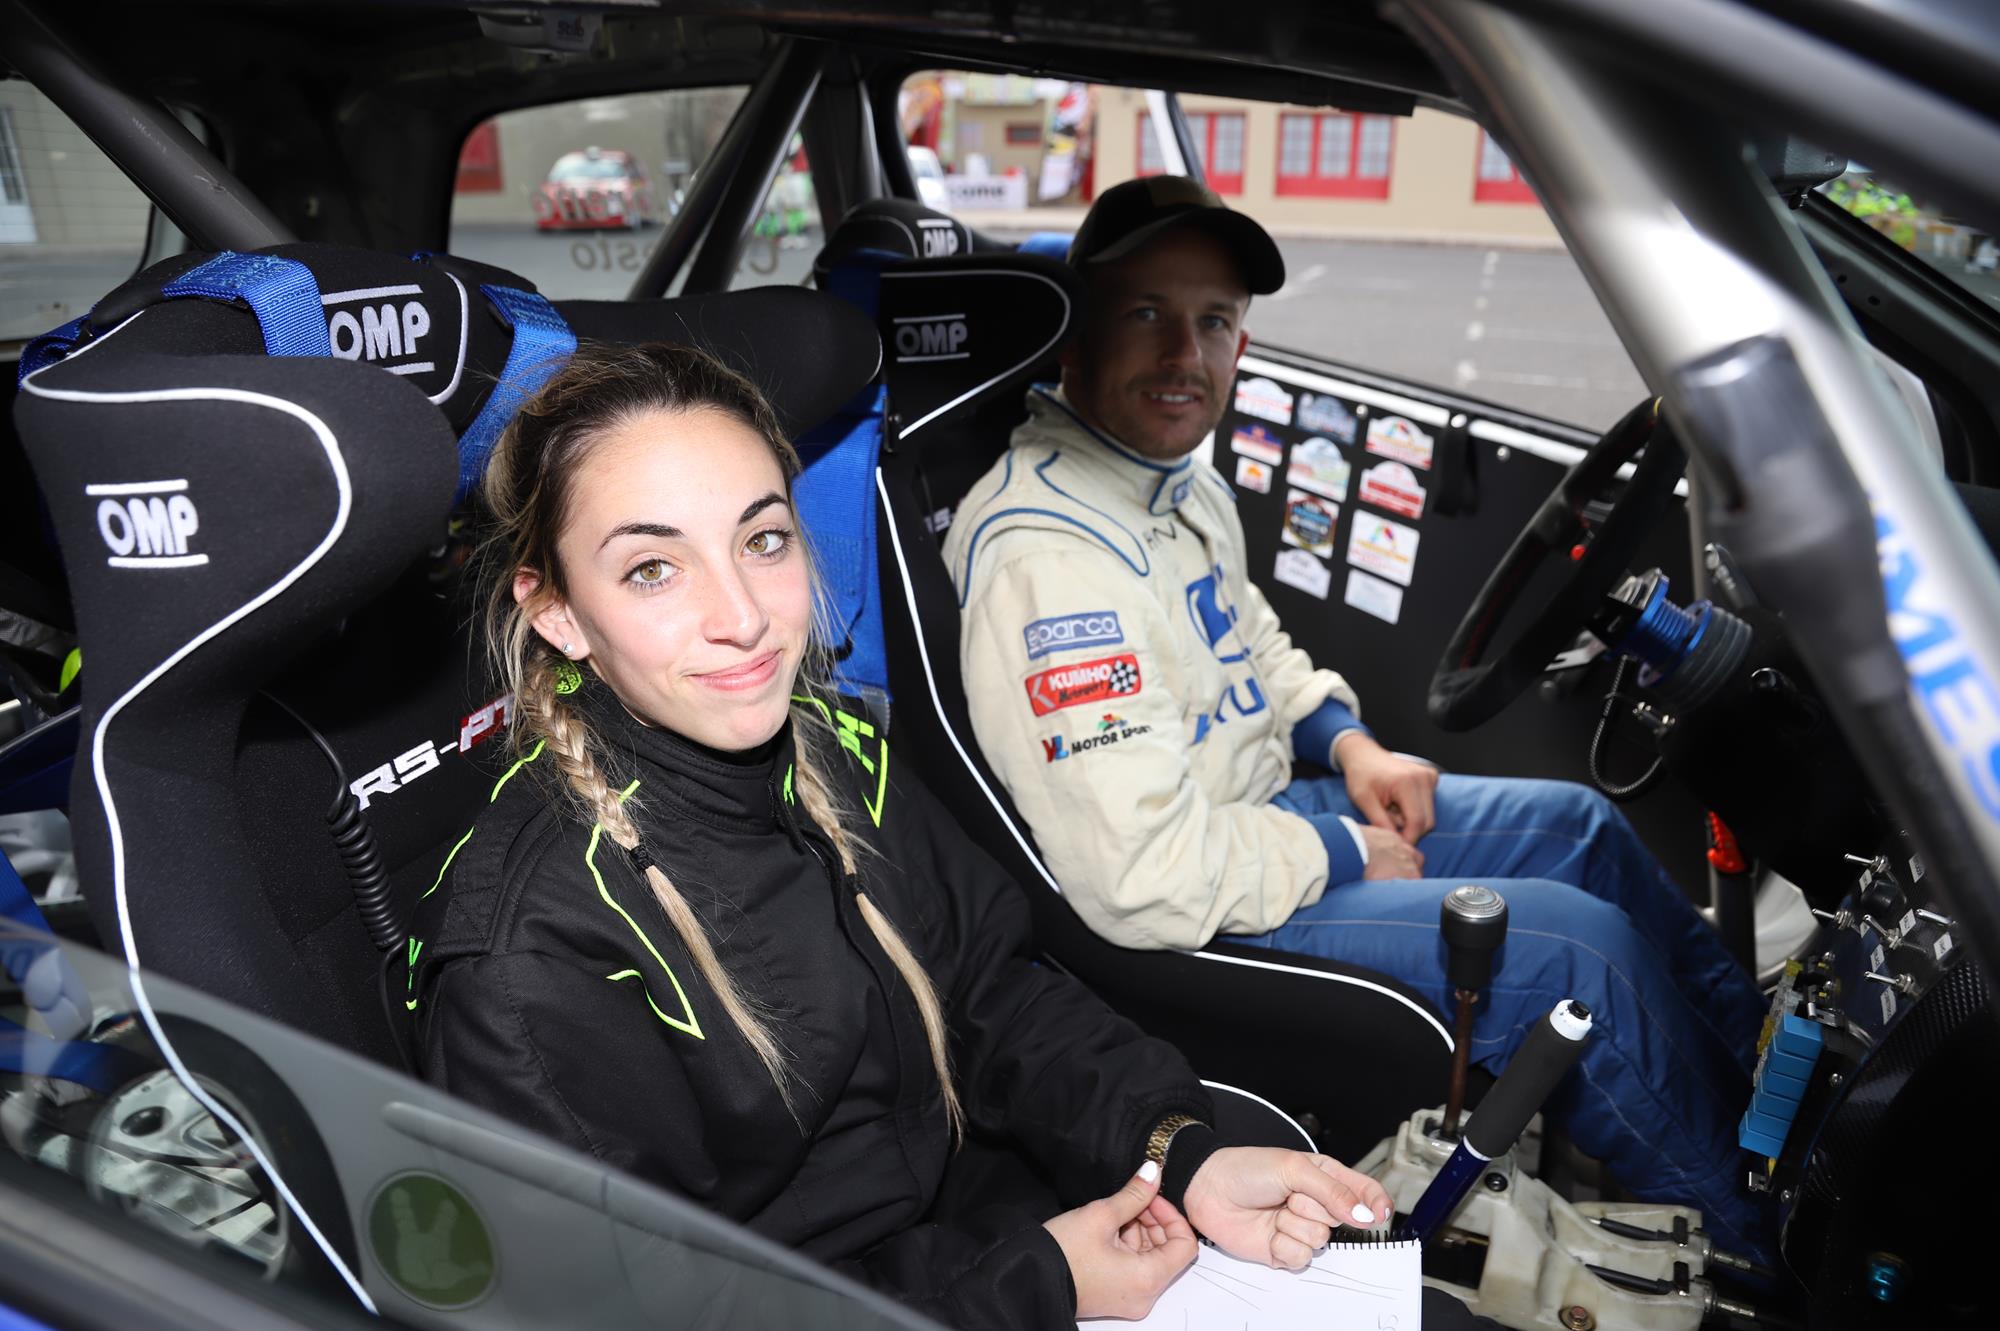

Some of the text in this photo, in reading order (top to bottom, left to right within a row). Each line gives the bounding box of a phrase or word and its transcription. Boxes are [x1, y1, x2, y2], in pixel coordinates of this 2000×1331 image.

[922, 228, 959, 258] OMP
[329, 300, 431, 361] OMP
[895, 321, 968, 355] OMP
[96, 494, 200, 556] OMP
[1047, 663, 1112, 691] KUMHO
[1071, 732, 1119, 755] MOTOR
